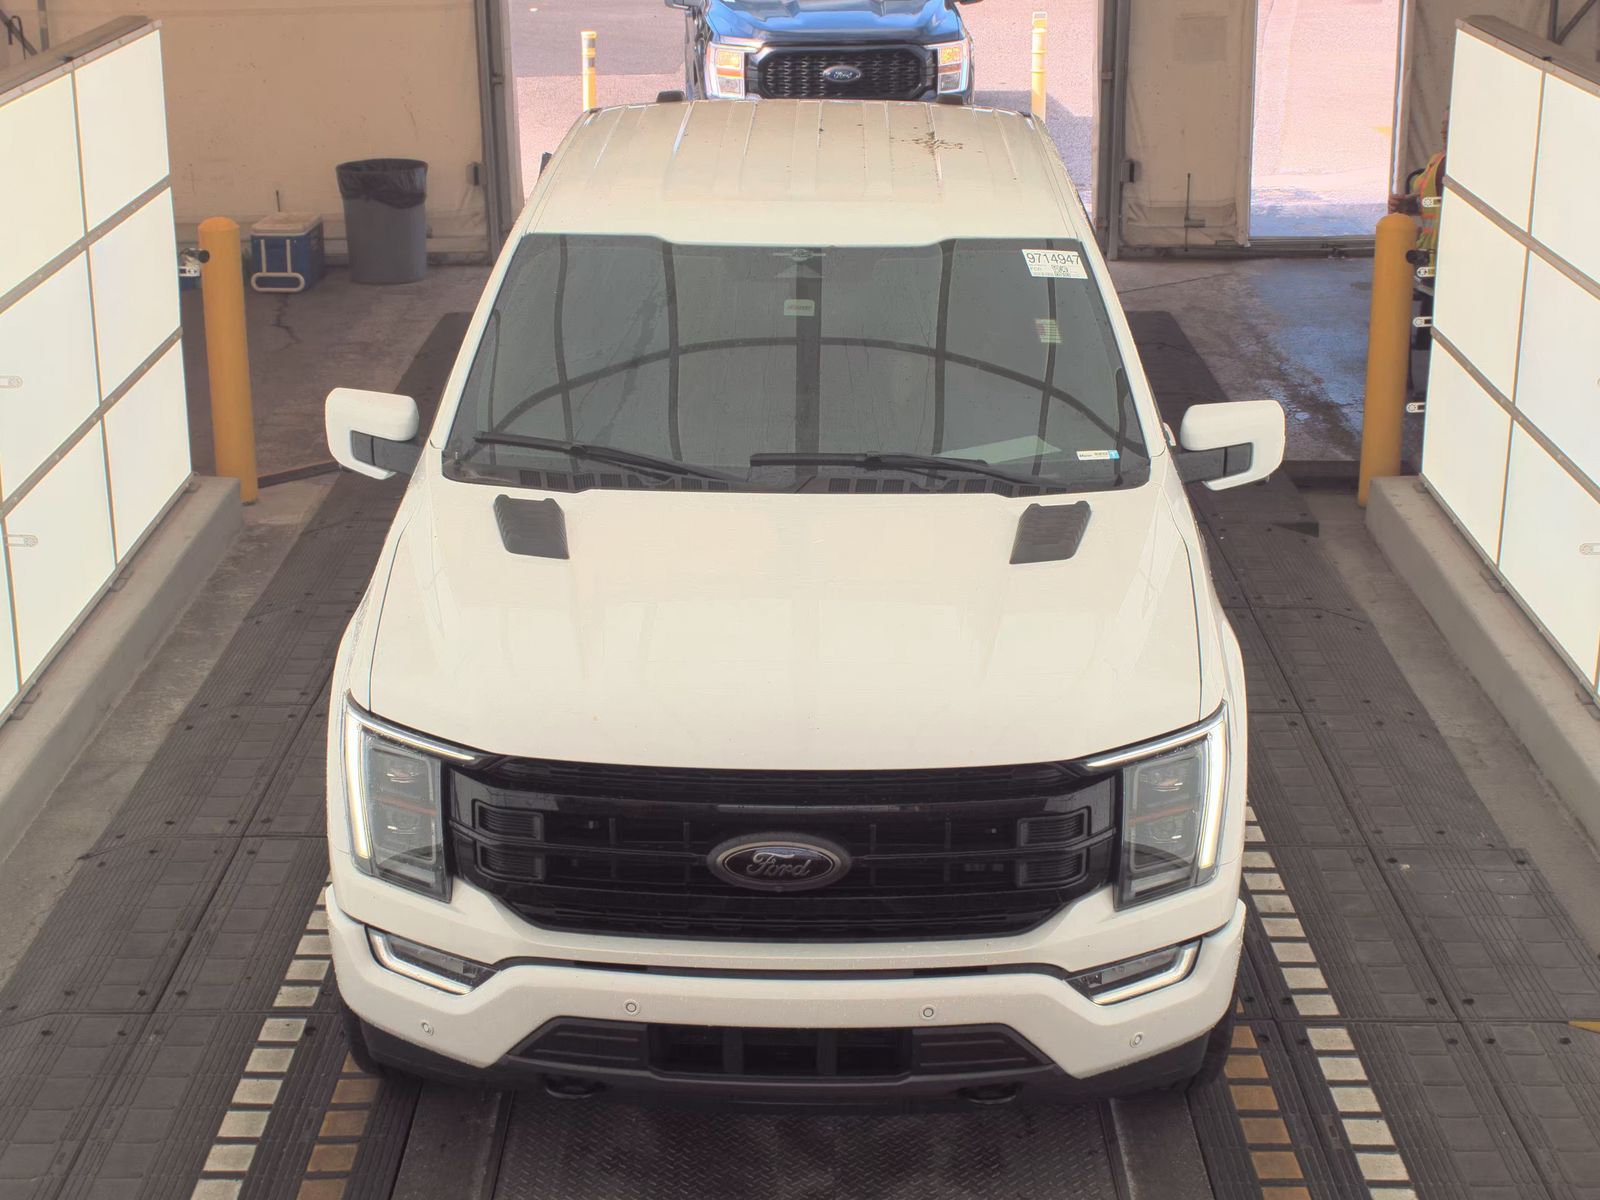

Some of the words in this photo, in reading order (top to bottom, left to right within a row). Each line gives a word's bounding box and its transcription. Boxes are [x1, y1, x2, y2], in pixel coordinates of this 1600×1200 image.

[833, 70, 853, 80] Ford
[1026, 252, 1080, 264] 9714947
[746, 852, 812, 877] Ford
